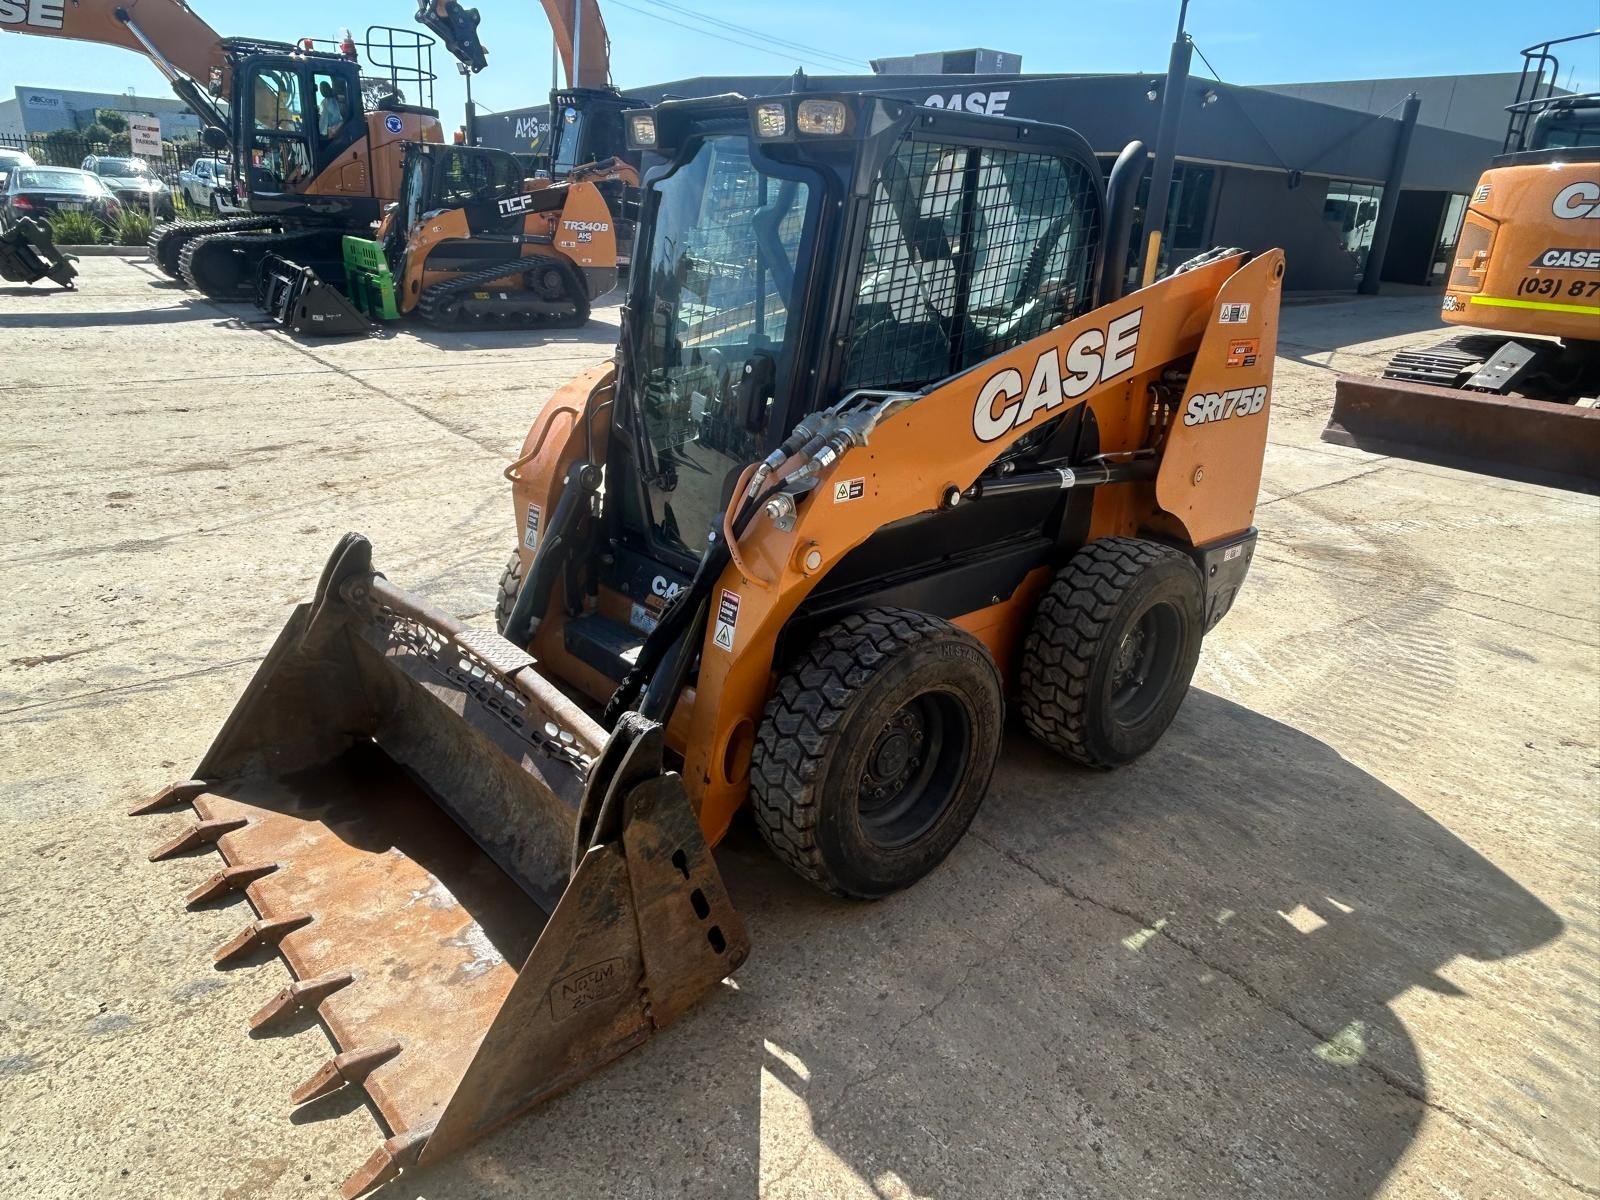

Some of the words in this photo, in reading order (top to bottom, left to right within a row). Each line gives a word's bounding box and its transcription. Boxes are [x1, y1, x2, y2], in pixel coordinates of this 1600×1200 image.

[515, 117, 539, 138] AHS
[1551, 181, 1600, 220] C
[563, 221, 608, 232] TR340B
[1542, 250, 1600, 268] CASE
[1517, 276, 1563, 298] (03)
[972, 305, 1144, 444] CASE
[1183, 384, 1268, 427] SR175B
